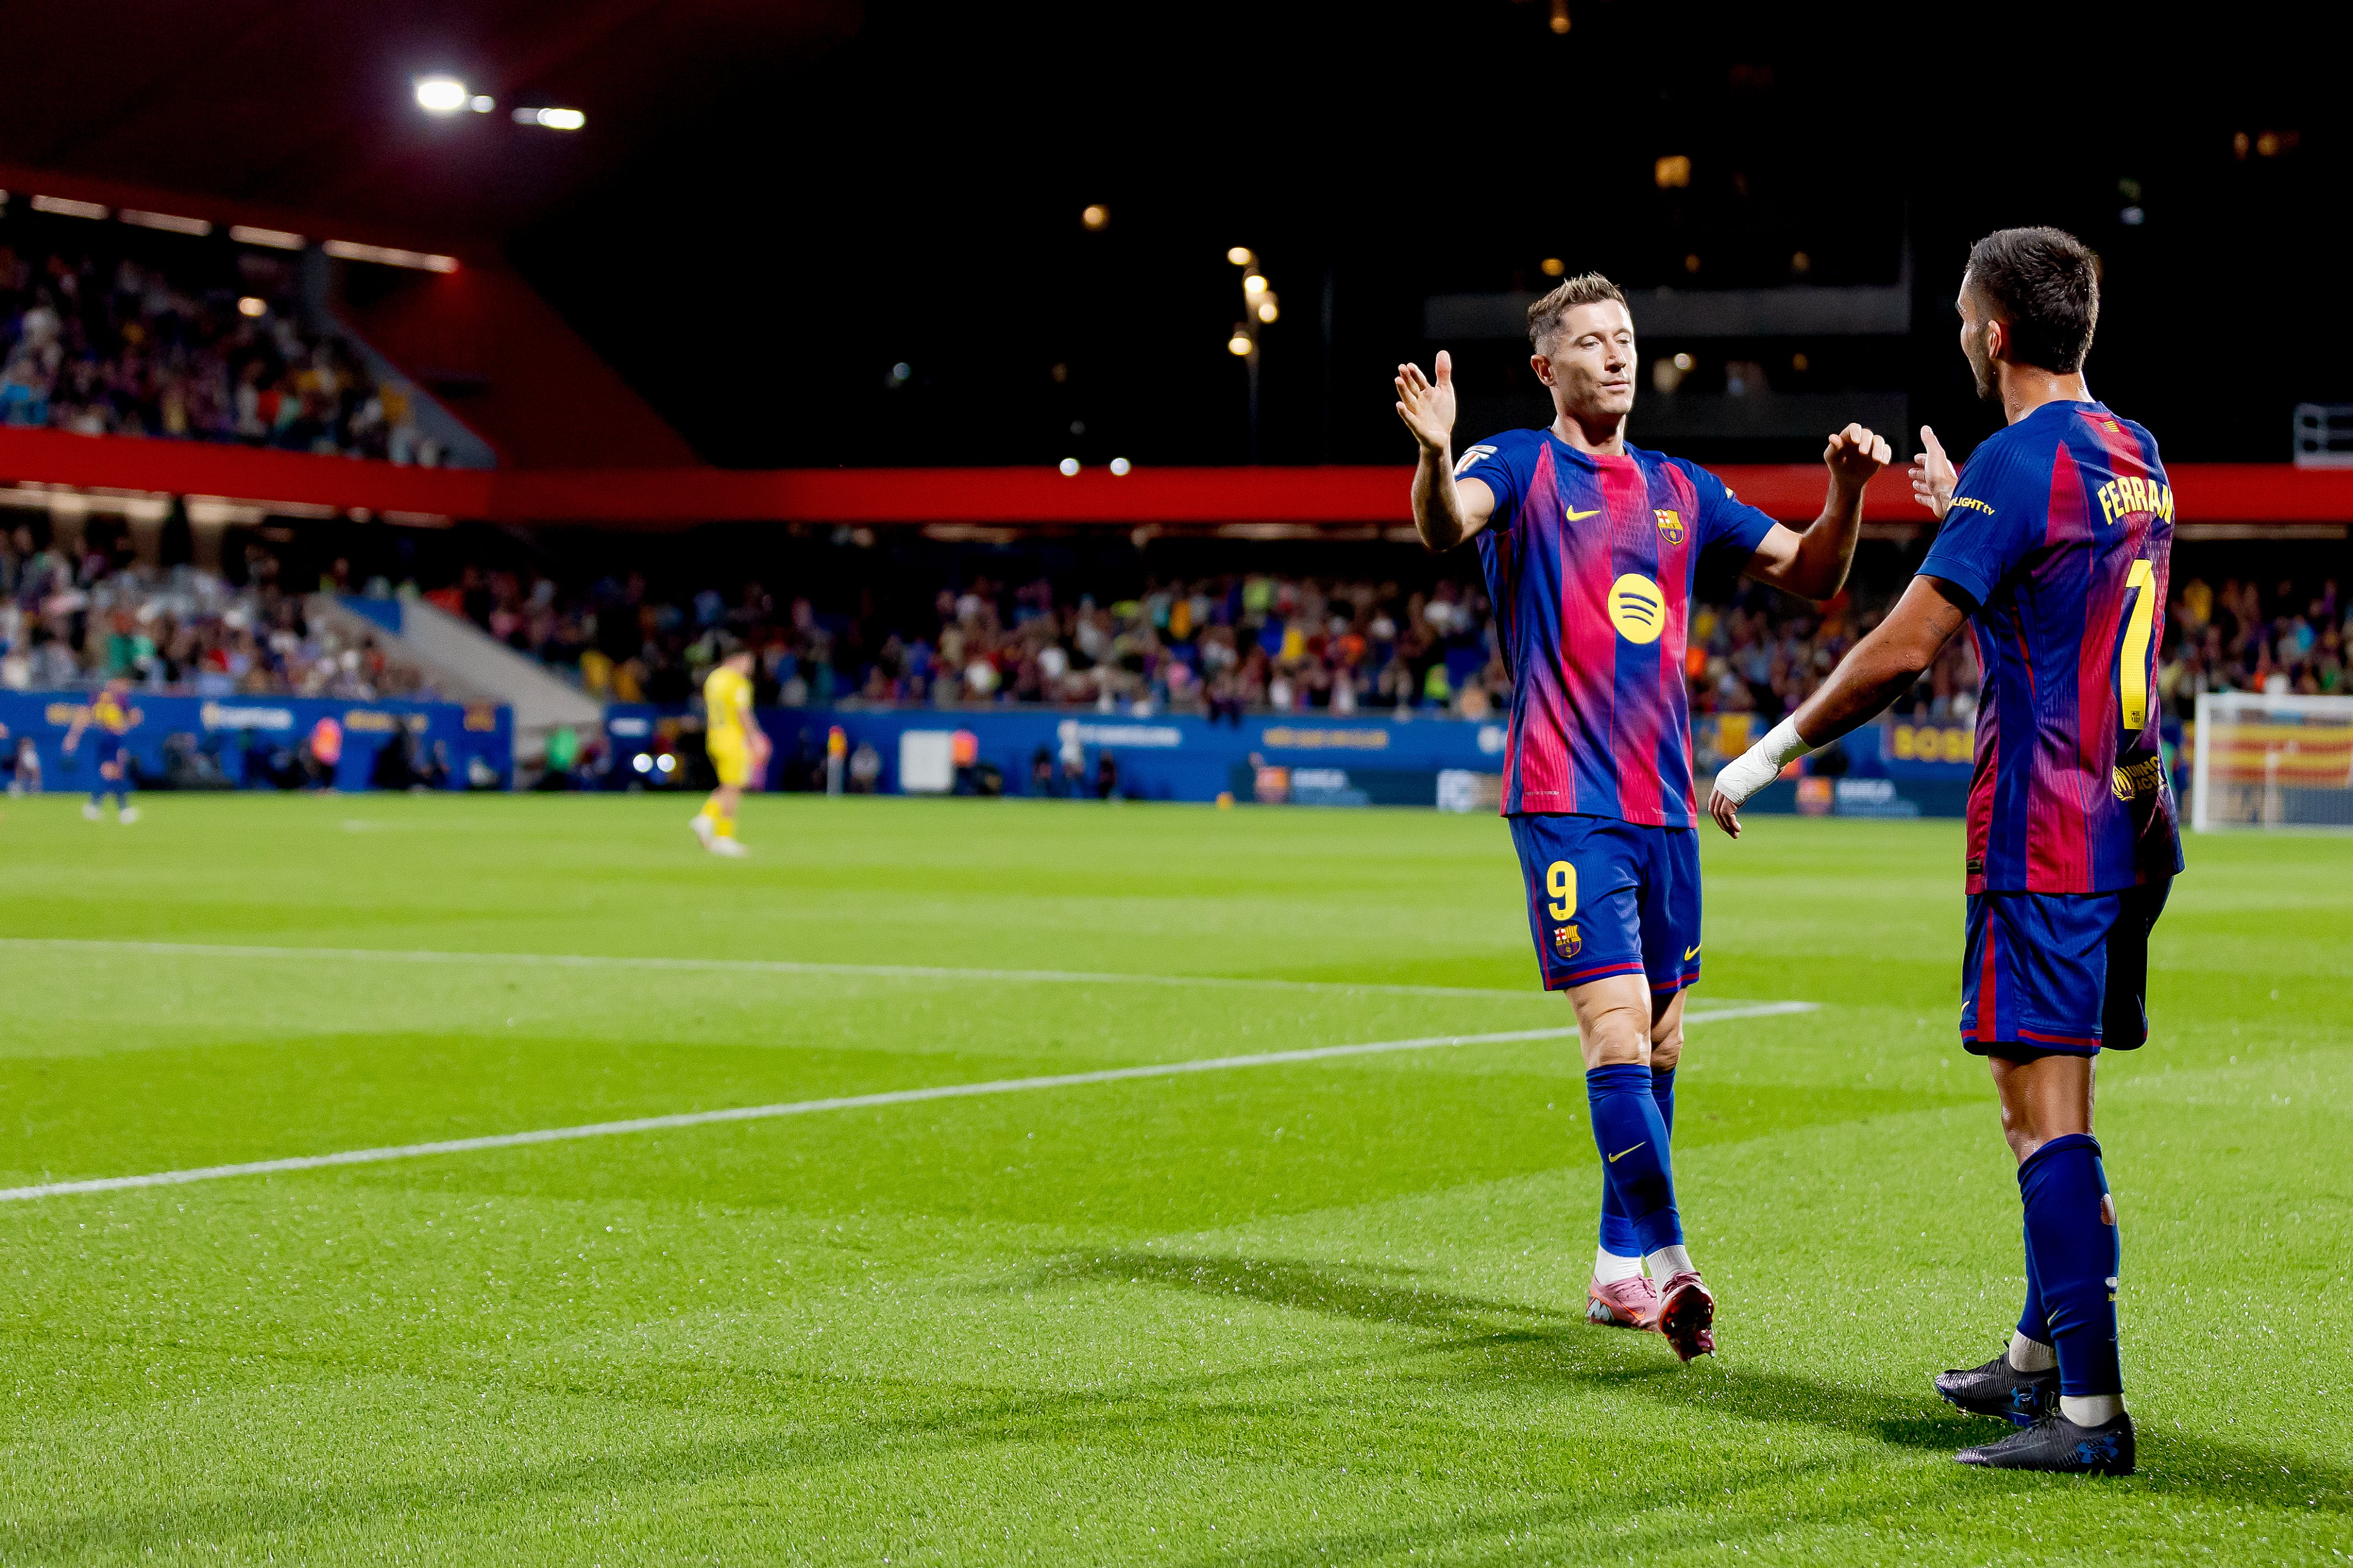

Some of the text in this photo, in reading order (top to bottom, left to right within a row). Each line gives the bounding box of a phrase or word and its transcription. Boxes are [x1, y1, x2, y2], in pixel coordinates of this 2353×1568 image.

[2097, 476, 2173, 525] FERRAN
[2121, 559, 2156, 730] 7
[1546, 860, 1577, 921] 9
